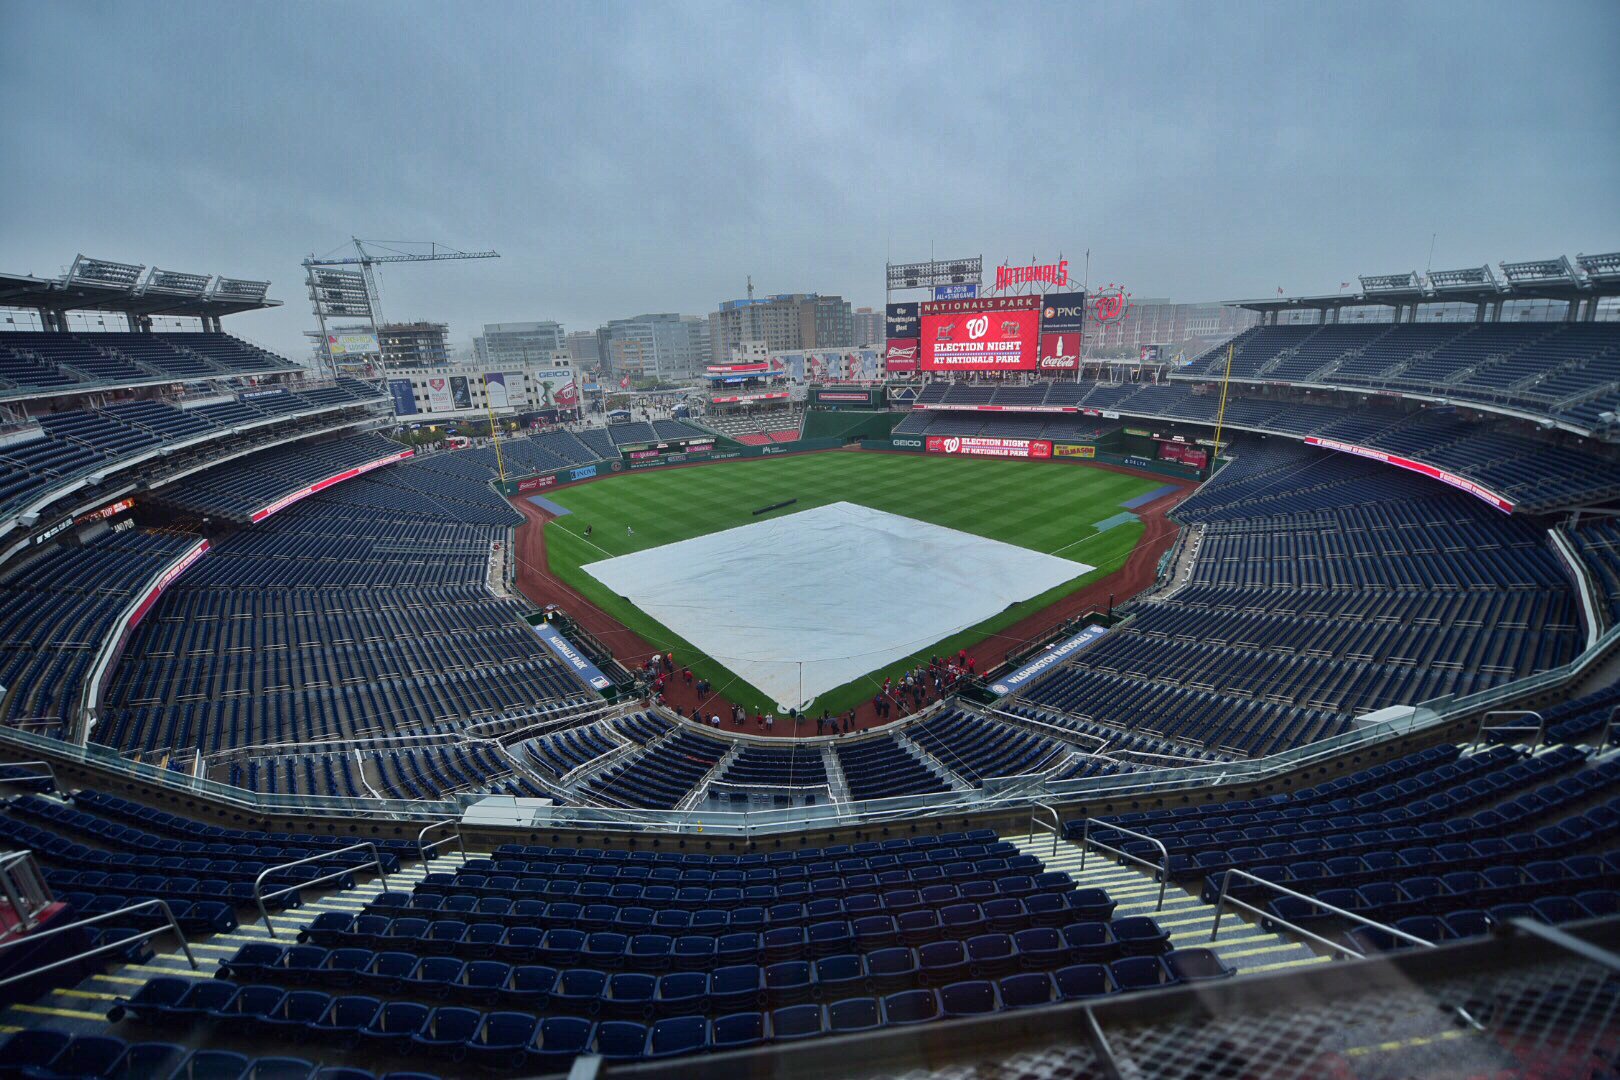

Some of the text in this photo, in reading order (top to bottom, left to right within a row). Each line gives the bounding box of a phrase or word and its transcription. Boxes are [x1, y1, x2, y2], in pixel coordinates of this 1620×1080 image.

[996, 261, 1068, 291] NATIONALS
[924, 298, 1033, 311] NATIONALS PARK
[1057, 307, 1081, 317] PNC
[966, 316, 988, 339] W
[934, 341, 1022, 352] ELECTION NIGHT
[946, 356, 993, 364] NATIONALS
[995, 355, 1020, 363] PARK
[1002, 439, 1029, 447] NIGHT
[970, 448, 1008, 456] NATIONALS
[577, 468, 596, 477] INOVA
[101, 507, 113, 518] TOP
[550, 636, 587, 669] NATIONALS PARK
[1007, 632, 1093, 684] WASHINGTON NATIONALS
